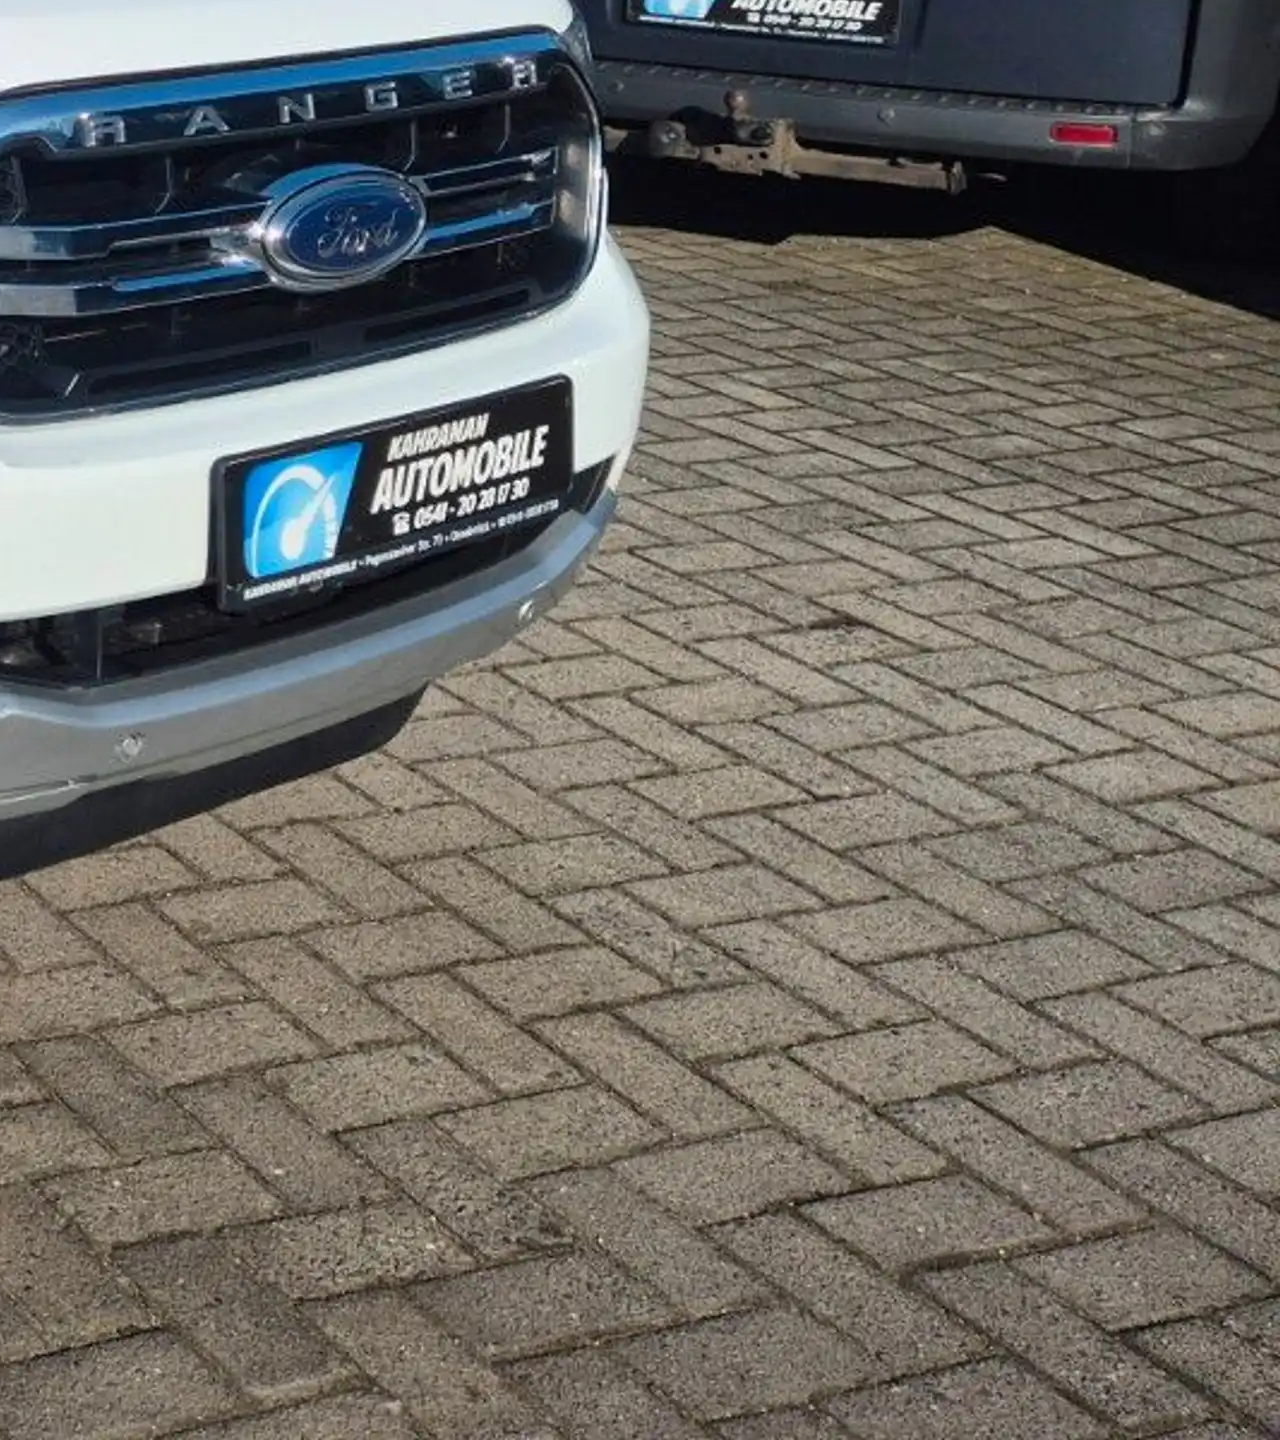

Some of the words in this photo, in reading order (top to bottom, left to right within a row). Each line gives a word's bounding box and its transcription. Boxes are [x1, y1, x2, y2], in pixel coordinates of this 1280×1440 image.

[79, 60, 538, 147] RANGER
[317, 206, 401, 259] Ford
[387, 413, 490, 462] KAHRAMAN
[369, 424, 550, 515] AUTOMOBILE
[413, 501, 449, 530] 0541
[456, 492, 478, 518] 20
[497, 482, 511, 505] 17
[509, 476, 531, 502] 30
